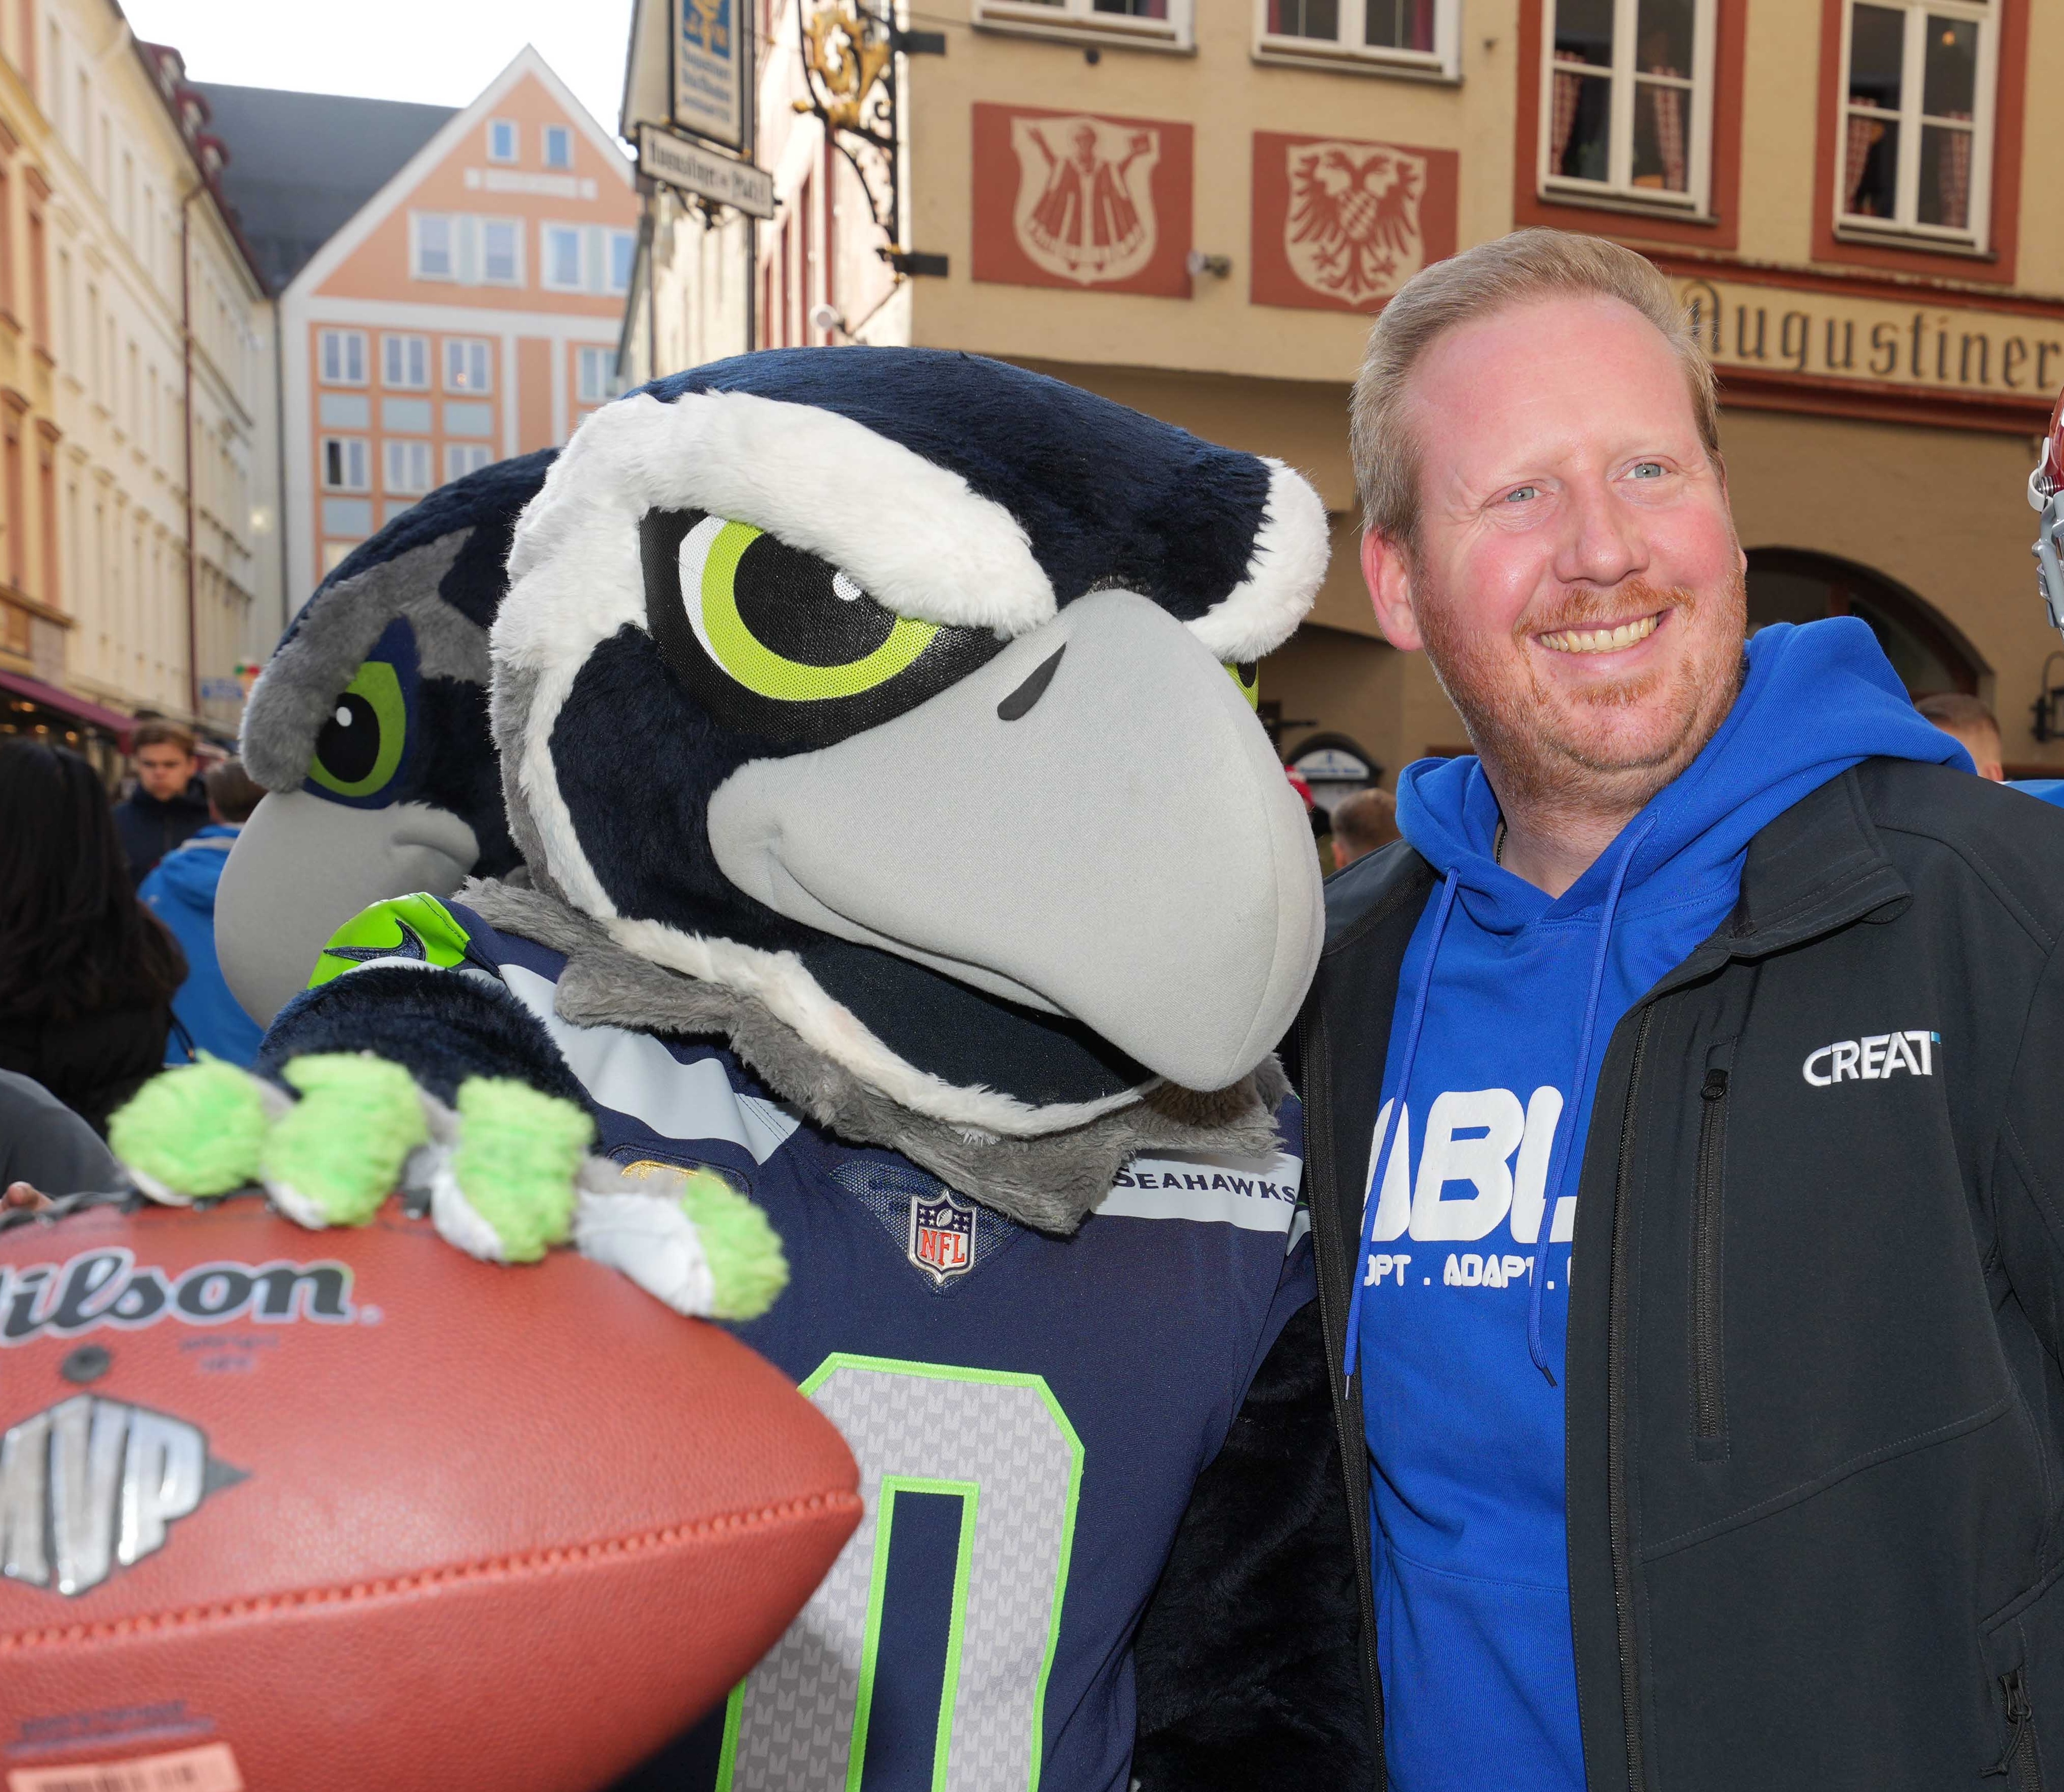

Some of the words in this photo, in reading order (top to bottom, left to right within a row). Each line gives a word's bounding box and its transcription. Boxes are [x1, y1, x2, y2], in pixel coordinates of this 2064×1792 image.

[1682, 279, 2061, 389] Augustiner
[1112, 1166, 1296, 1205] SEAHAWKS
[919, 1229, 965, 1266] NFL
[0, 1249, 354, 1344] ilson
